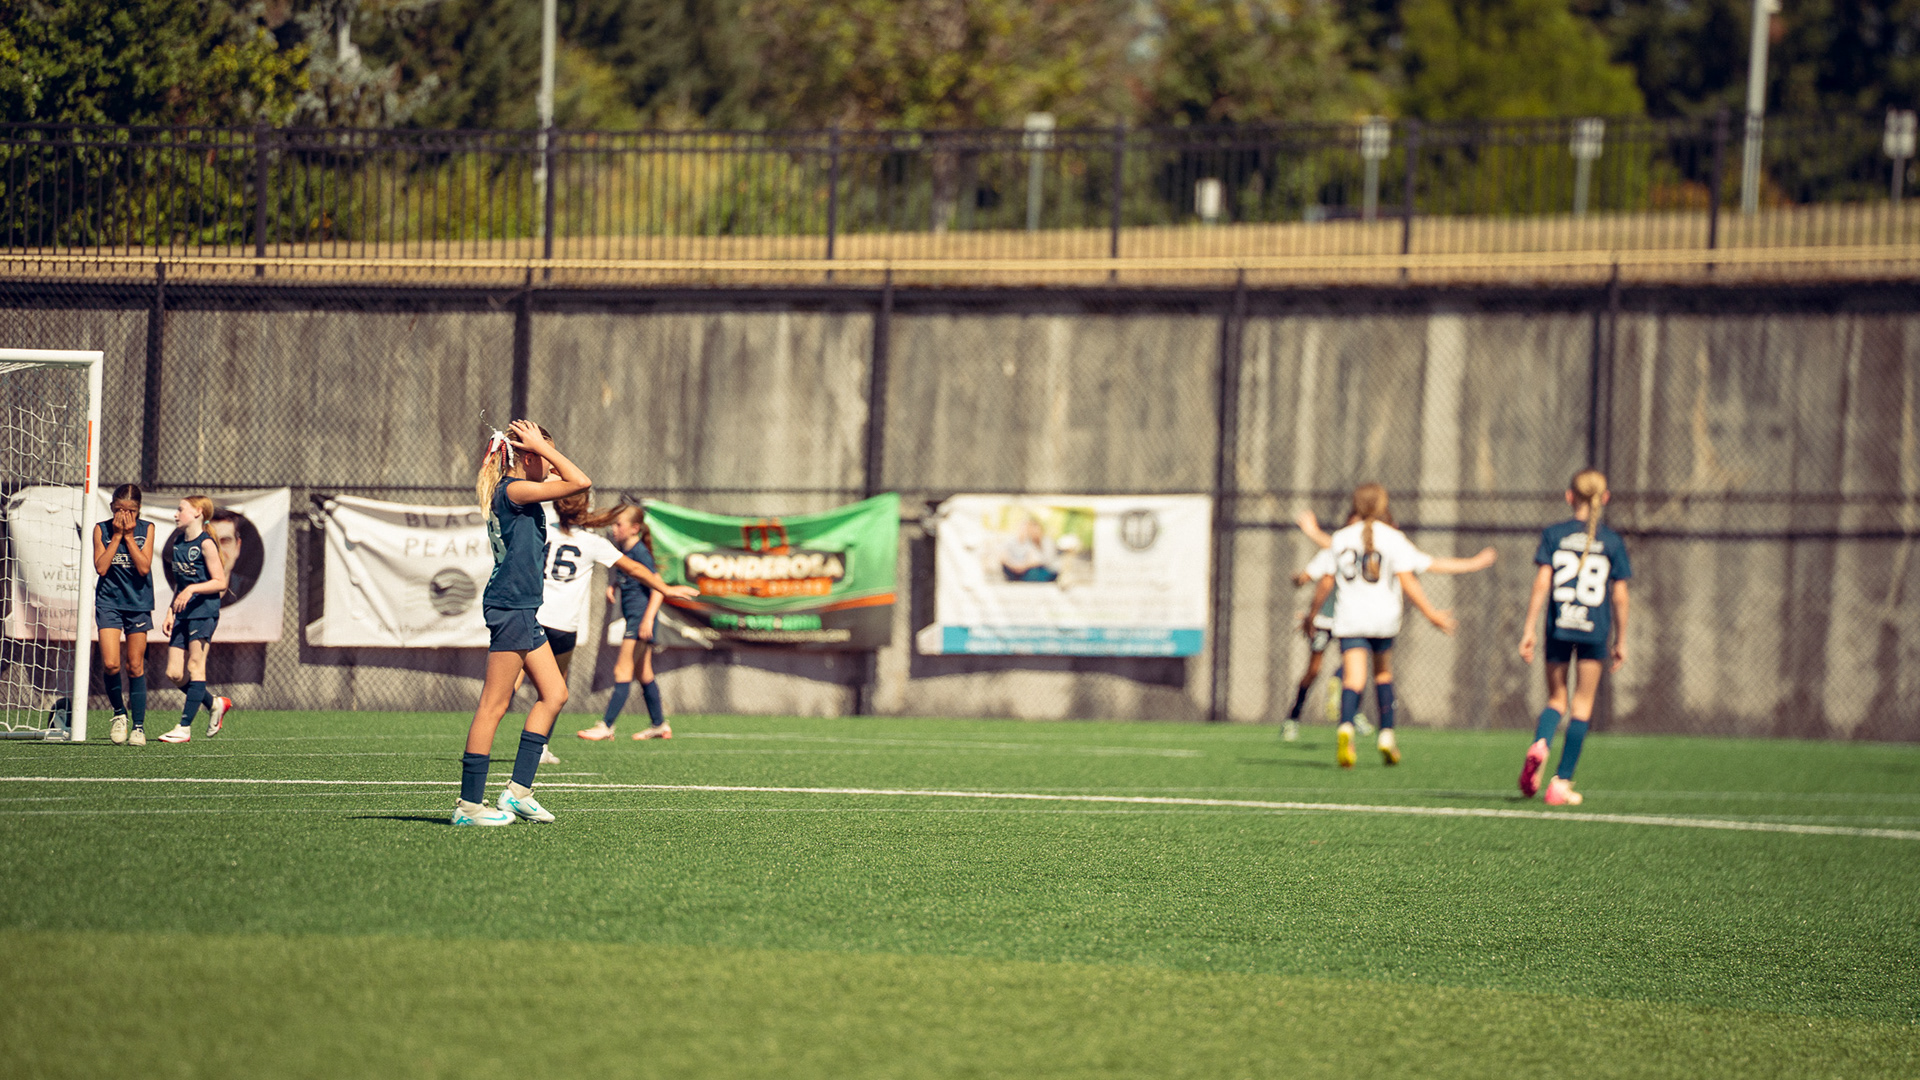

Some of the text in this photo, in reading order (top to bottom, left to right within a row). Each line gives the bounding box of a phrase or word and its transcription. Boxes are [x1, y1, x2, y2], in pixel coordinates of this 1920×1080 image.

[404, 511, 485, 529] BLAC
[43, 570, 80, 580] WELL
[541, 541, 582, 583] 16
[1552, 549, 1611, 608] 28
